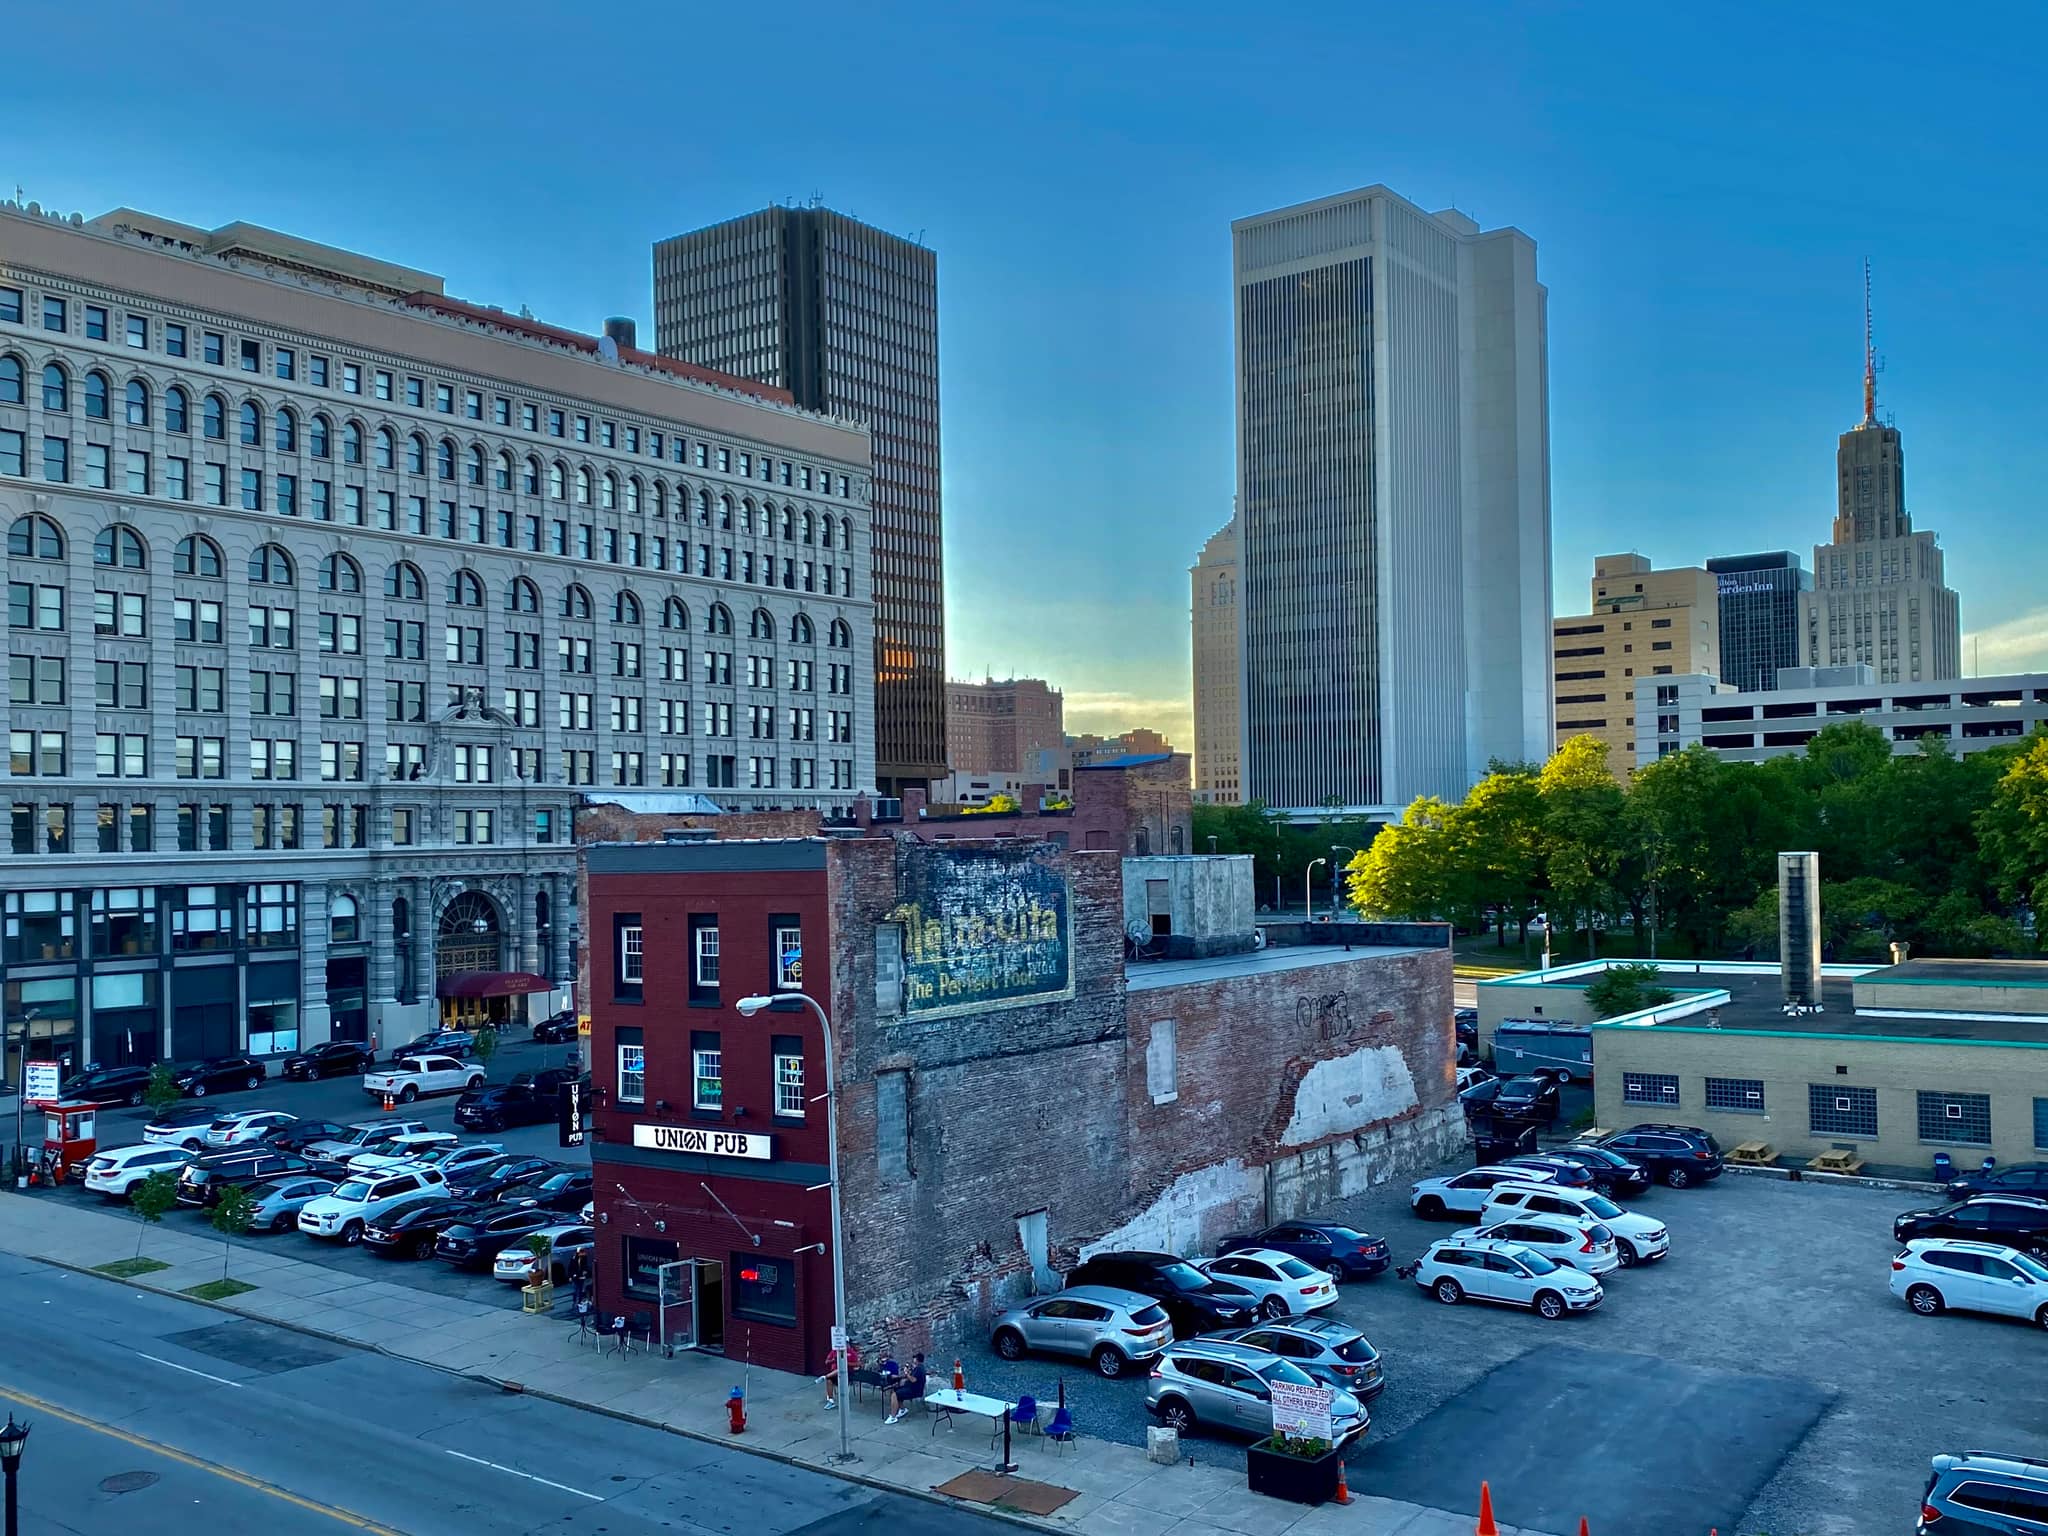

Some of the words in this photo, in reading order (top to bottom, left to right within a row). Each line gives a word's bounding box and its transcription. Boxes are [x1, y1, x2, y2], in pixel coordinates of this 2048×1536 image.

[1754, 582, 1773, 591] Inn
[908, 973, 933, 999] The
[568, 1132, 583, 1143] PUB
[714, 1134, 748, 1154] PUB
[1271, 1381, 1295, 1393] PARKING
[1296, 1385, 1329, 1399] RESTRICTED
[1282, 1395, 1303, 1407] OTHERS
[1304, 1399, 1318, 1409] KEEP
[1318, 1402, 1330, 1411] OUT
